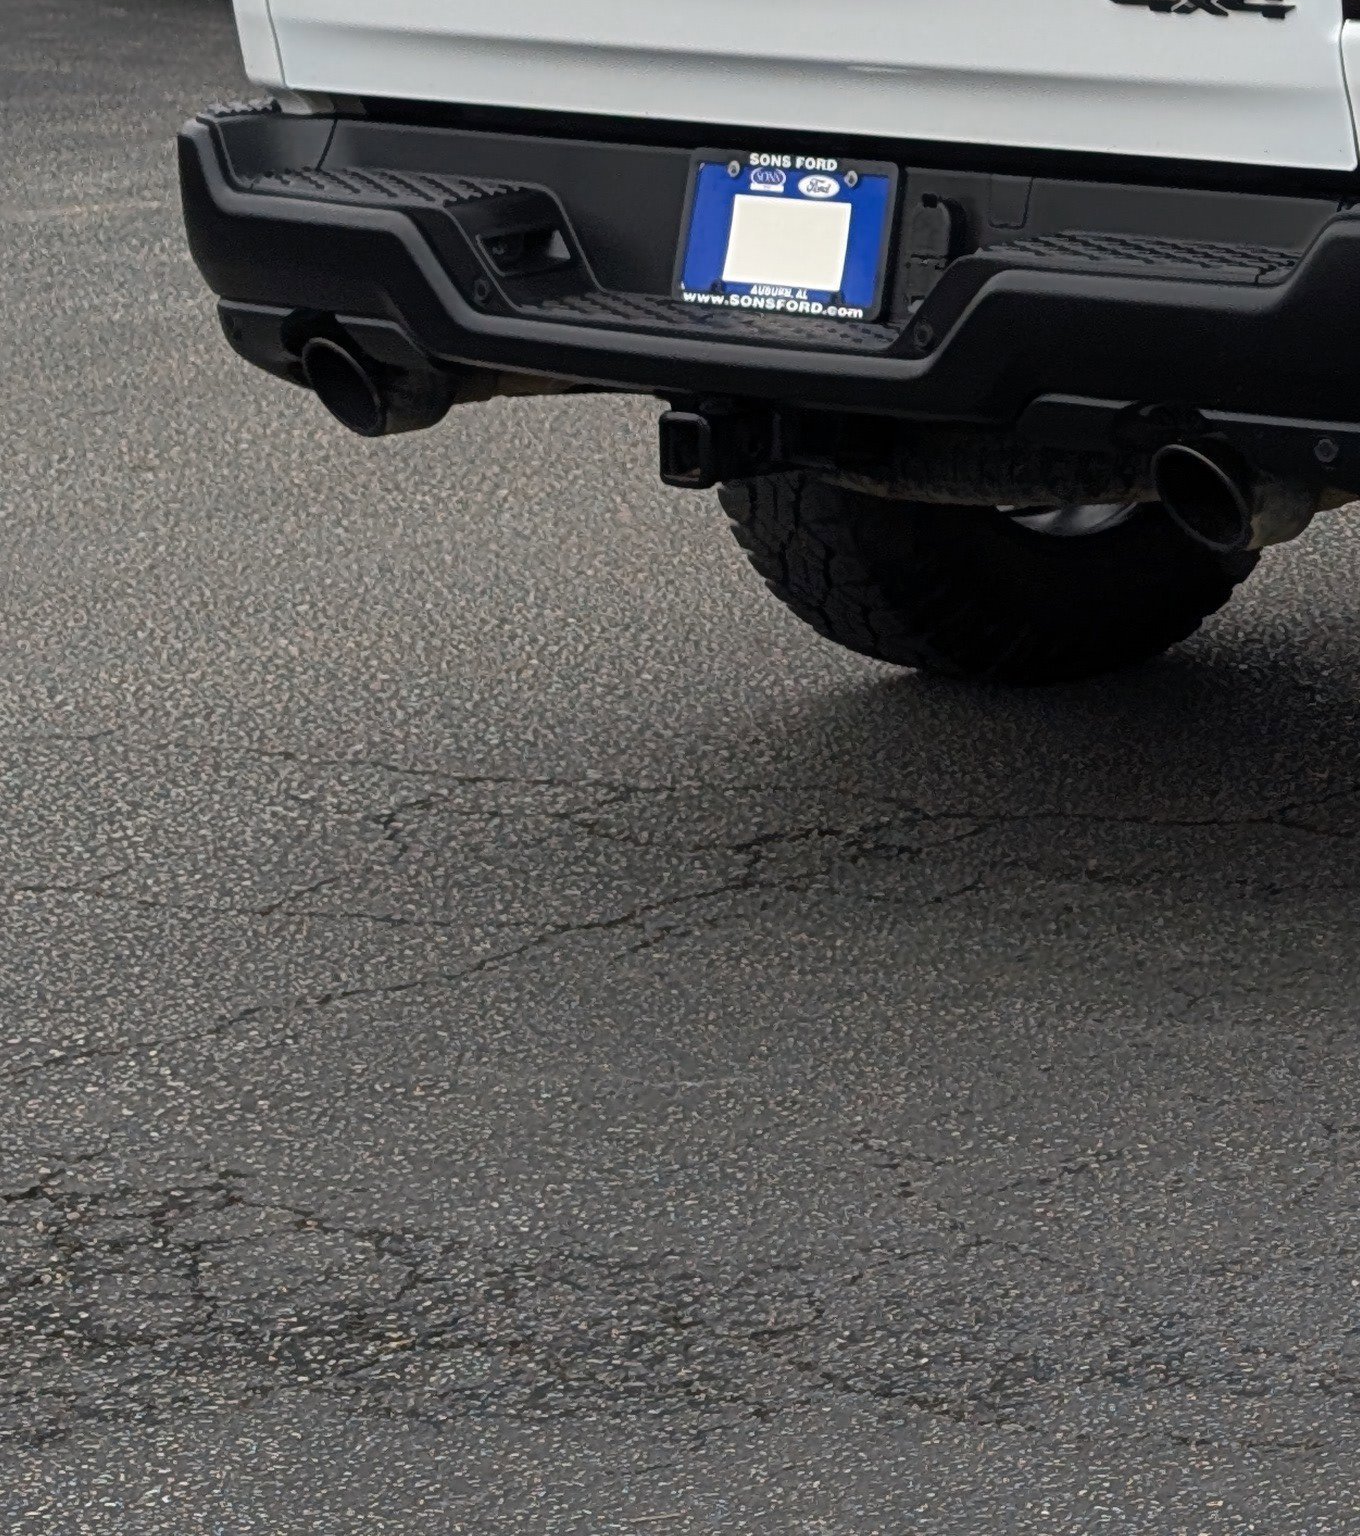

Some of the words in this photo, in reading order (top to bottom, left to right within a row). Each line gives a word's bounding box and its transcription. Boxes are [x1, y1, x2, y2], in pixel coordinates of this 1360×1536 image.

[750, 152, 791, 168] SONS
[796, 157, 838, 172] FORD
[806, 177, 832, 194] Ford
[683, 292, 863, 319] www.SONSFORD.com
